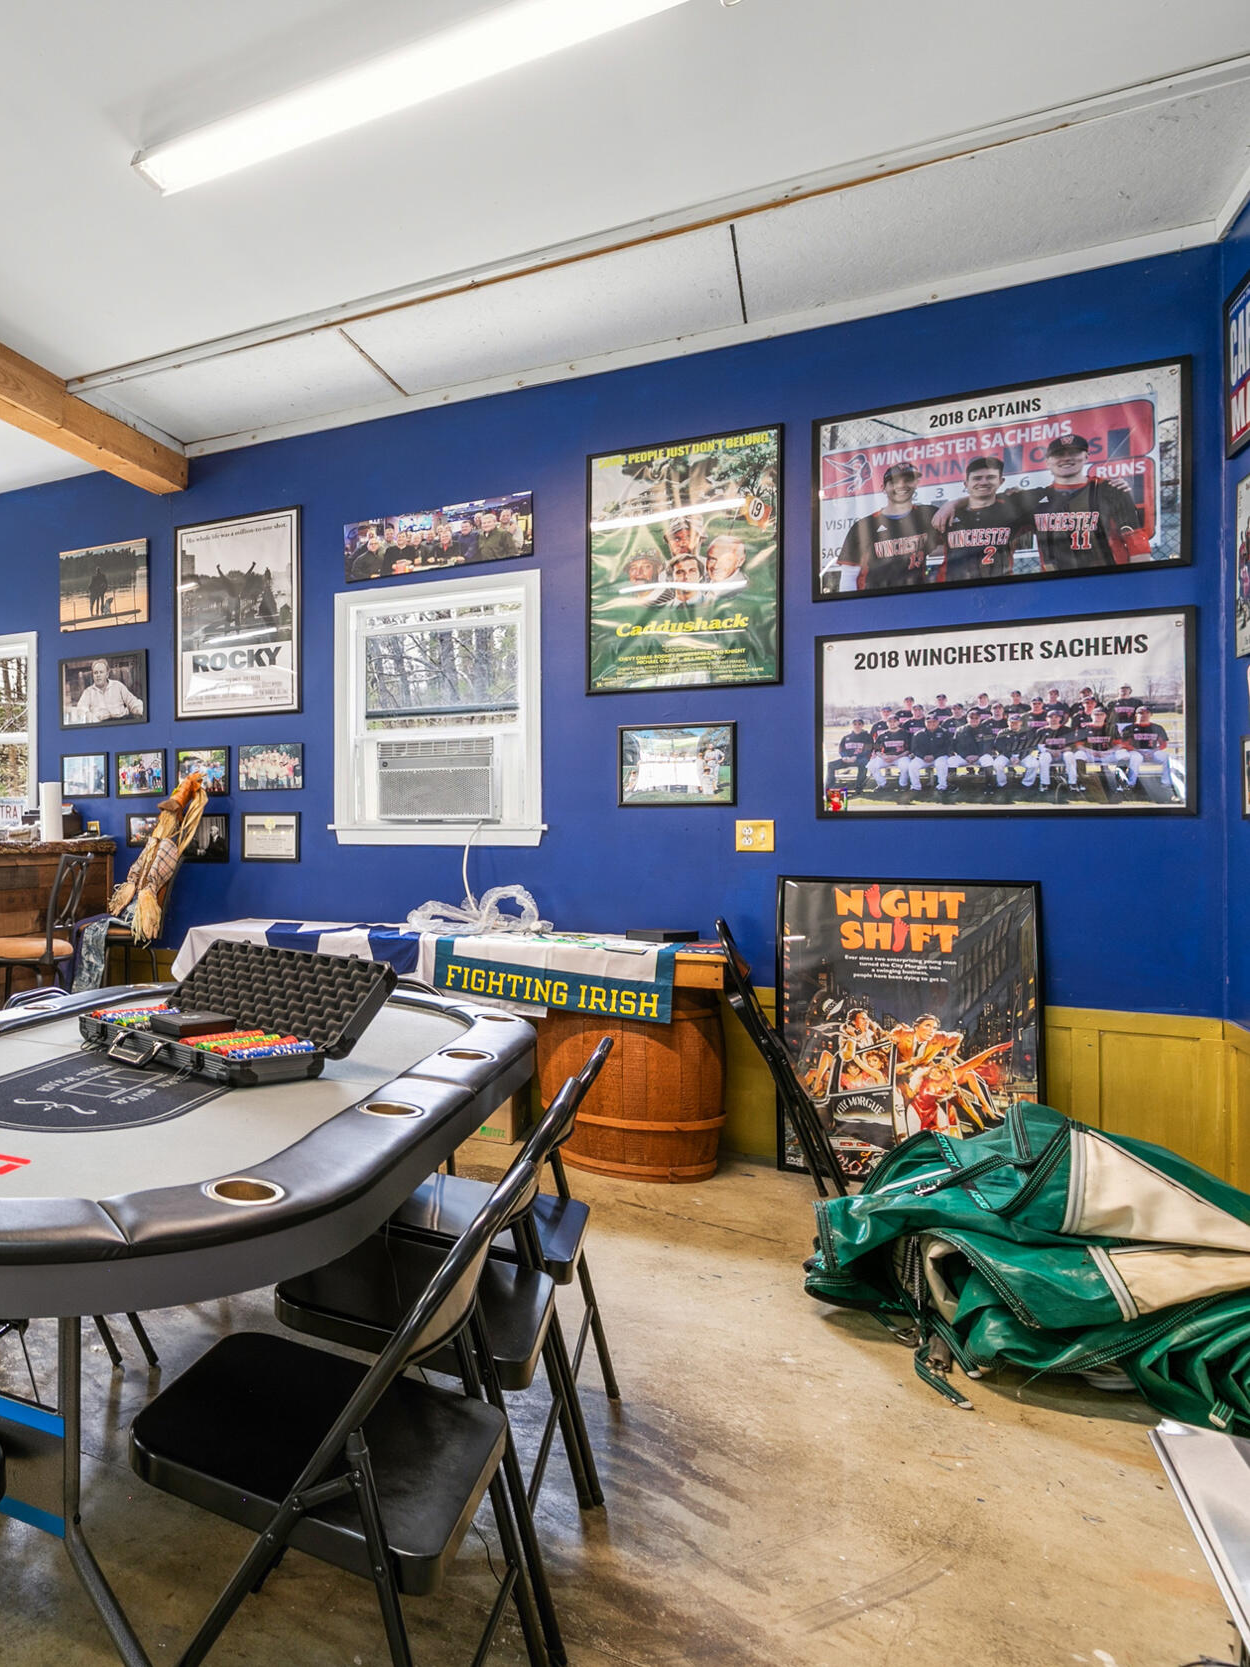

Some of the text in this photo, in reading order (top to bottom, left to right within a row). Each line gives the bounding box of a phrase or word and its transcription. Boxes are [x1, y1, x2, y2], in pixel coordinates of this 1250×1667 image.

[929, 397, 1042, 429] 2018 CAPTAINS
[628, 449, 665, 465] PEOPLE
[665, 445, 690, 459] JUST
[691, 438, 726, 454] DON'T
[871, 434, 977, 468] WINCHESTER
[980, 419, 1073, 451] SACHEMS
[1096, 460, 1147, 478] RUNS
[935, 475, 1031, 499] 3 6
[750, 499, 763, 517] 19
[1033, 511, 1100, 532] WINCHESTER
[947, 527, 1011, 550] WINCHESTER
[1070, 530, 1092, 551] 11
[981, 545, 998, 565] 2
[615, 613, 750, 638] Caddyshack
[191, 646, 282, 674] ROCKY
[854, 633, 1149, 670] 2018 WINCHESTER SACHEMS
[834, 883, 966, 919] NIGHT
[839, 916, 960, 953] SHIFT
[445, 964, 660, 1018] FIGHTING IRISH
[847, 1095, 886, 1115] MORGUE
